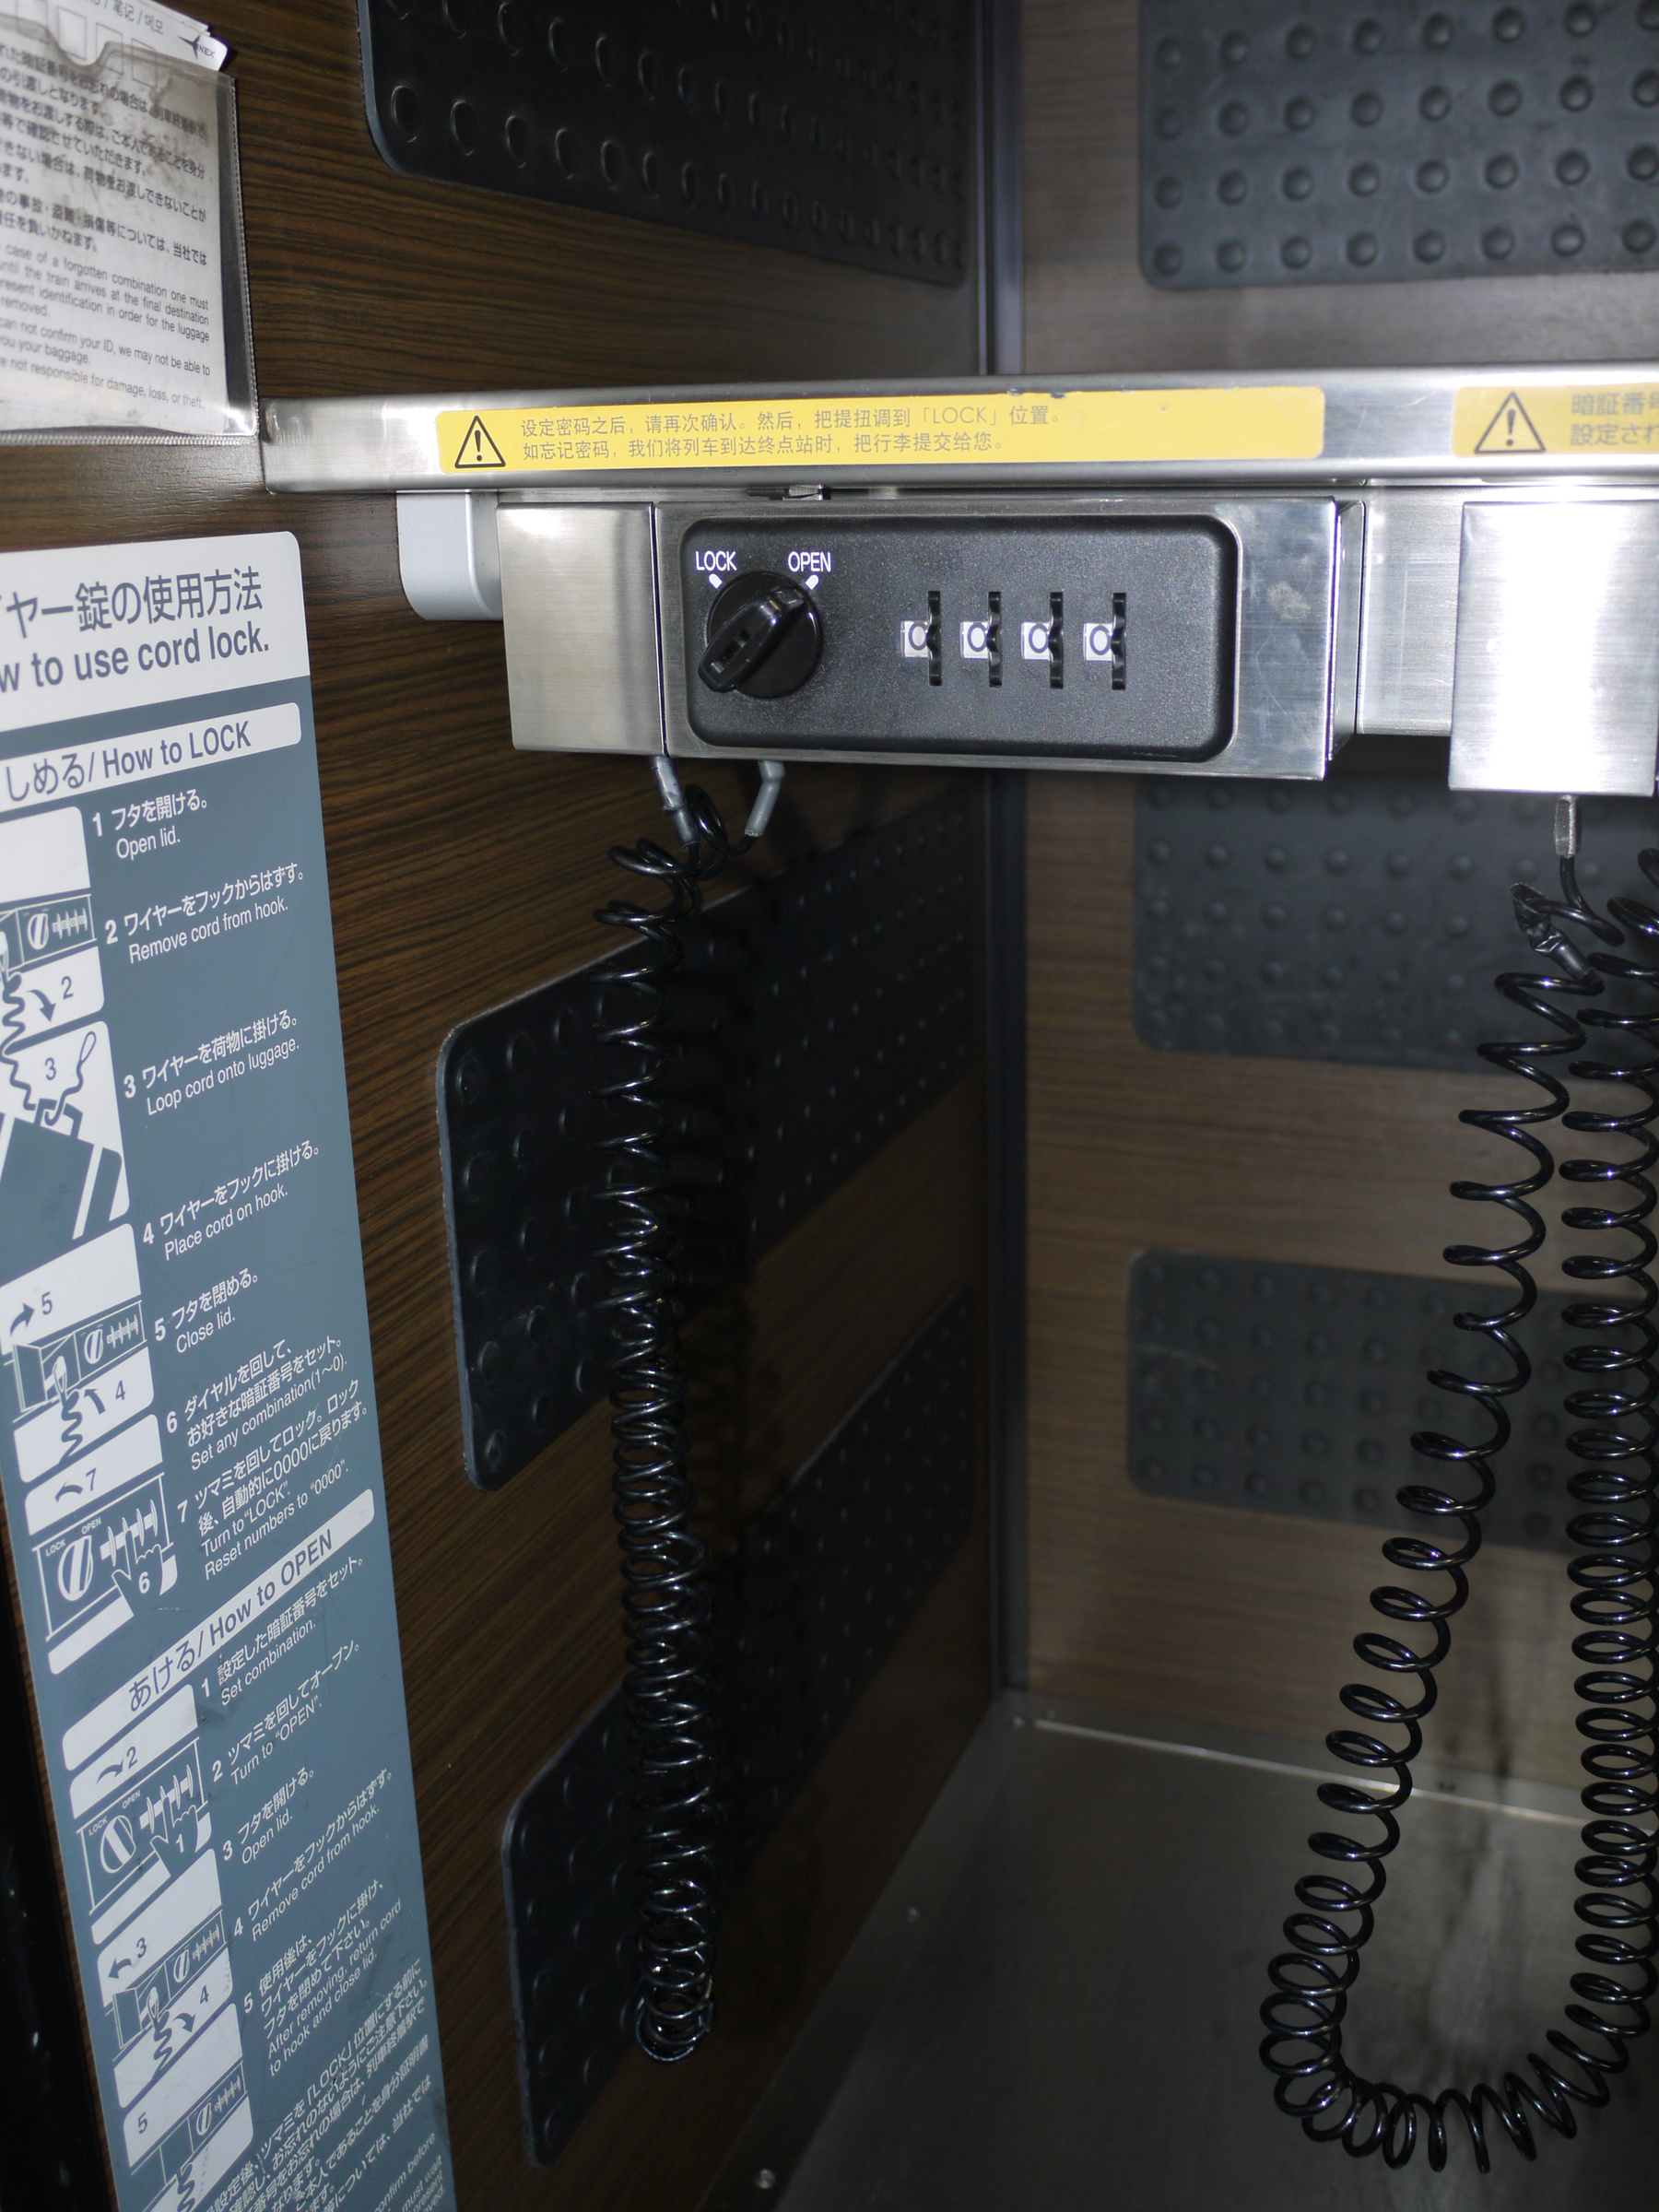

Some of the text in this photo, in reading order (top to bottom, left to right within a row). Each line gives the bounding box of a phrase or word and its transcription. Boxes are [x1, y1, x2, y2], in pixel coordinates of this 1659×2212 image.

[25, 265, 209, 326] the train arrives at the final destination
[37, 252, 209, 311] of forgotten combination one must
[40, 285, 210, 346] identification in order for the luggage
[18, 340, 91, 366] your baggage.
[20, 323, 211, 376] not confirm your we may not be able to
[10, 359, 28, 371] not
[30, 362, 89, 384] responsible
[91, 373, 104, 387] for
[107, 378, 147, 398] damage,
[148, 386, 170, 403] loss,
[171, 394, 182, 404] or
[695, 550, 831, 572] LOCK OPEN
[0, 565, 264, 639] ヤー錠の使用方法
[31, 652, 64, 688] to
[74, 647, 130, 681] use
[138, 628, 201, 670] cord
[208, 620, 269, 660] lock.
[102, 747, 153, 779] How
[160, 738, 182, 765] to
[189, 720, 252, 759] LOCK
[92, 788, 207, 837] 1 フタを開ける。
[116, 825, 181, 861] Open lid.
[104, 919, 118, 945] 2
[124, 862, 303, 936] ワイヤーをフックからはずす。
[128, 895, 288, 964] Remove cord from hook.
[61, 975, 74, 1000] 2
[44, 1057, 57, 1081] 3
[124, 1009, 297, 1099] 3 ワイヤーを荷物に掛ける。
[147, 1038, 300, 1115] Loop cord onto luggage.
[143, 1139, 319, 1244] 4 ワイヤーをフックに掛ける。
[164, 1182, 288, 1261] Place cord on hook.
[41, 1290, 53, 1315] 5
[154, 1317, 166, 1341] 5
[171, 1267, 258, 1329] フタを閉める。
[176, 1306, 236, 1353] Close lid.
[115, 1379, 126, 1401] 4
[166, 1338, 291, 1433] 6 ダイヤルを回して、
[187, 1335, 341, 1447] お好きな暗証番号をセット。
[191, 1443, 214, 1471] Set
[217, 1428, 239, 1454] any
[85, 1466, 97, 1491] 7
[81, 1516, 102, 1535] OPEN
[177, 1499, 188, 1523] 7
[45, 1537, 66, 1558] LOCK
[201, 1532, 230, 1557] Turn
[232, 1518, 244, 1535] to
[205, 1541, 242, 1581] Reset
[244, 1502, 295, 1550] numbers
[296, 1492, 309, 1510] to
[138, 1571, 150, 1594] 6
[209, 1598, 252, 1646] How
[256, 1581, 276, 1607] to
[280, 1528, 334, 1586] OPEN
[201, 1556, 363, 1698] 1 設定した暗証番号をセット。
[221, 1618, 316, 1706] Set combination.
[126, 1746, 138, 1770] 2
[212, 1759, 223, 1783] 2
[230, 1754, 260, 1785] Turn
[261, 1741, 274, 1759] to
[122, 1789, 141, 1809] OPEN
[222, 1766, 314, 1862] 3 フタを開ける。
[88, 1815, 109, 1836] LOCK
[175, 1833, 184, 1853] 1
[241, 1808, 293, 1865] Open lid.
[233, 1768, 392, 1936] 4 ワイヤーをフックからはずす。
[252, 1804, 380, 1942] Remove cord from hook.
[135, 1936, 147, 1959] 3
[199, 1984, 210, 2006] 4
[243, 1991, 253, 2014] 5
[268, 1897, 402, 2060] After removing, return cord
[269, 1947, 377, 2077] to hook and close lid.
[137, 2111, 148, 2135] 5
